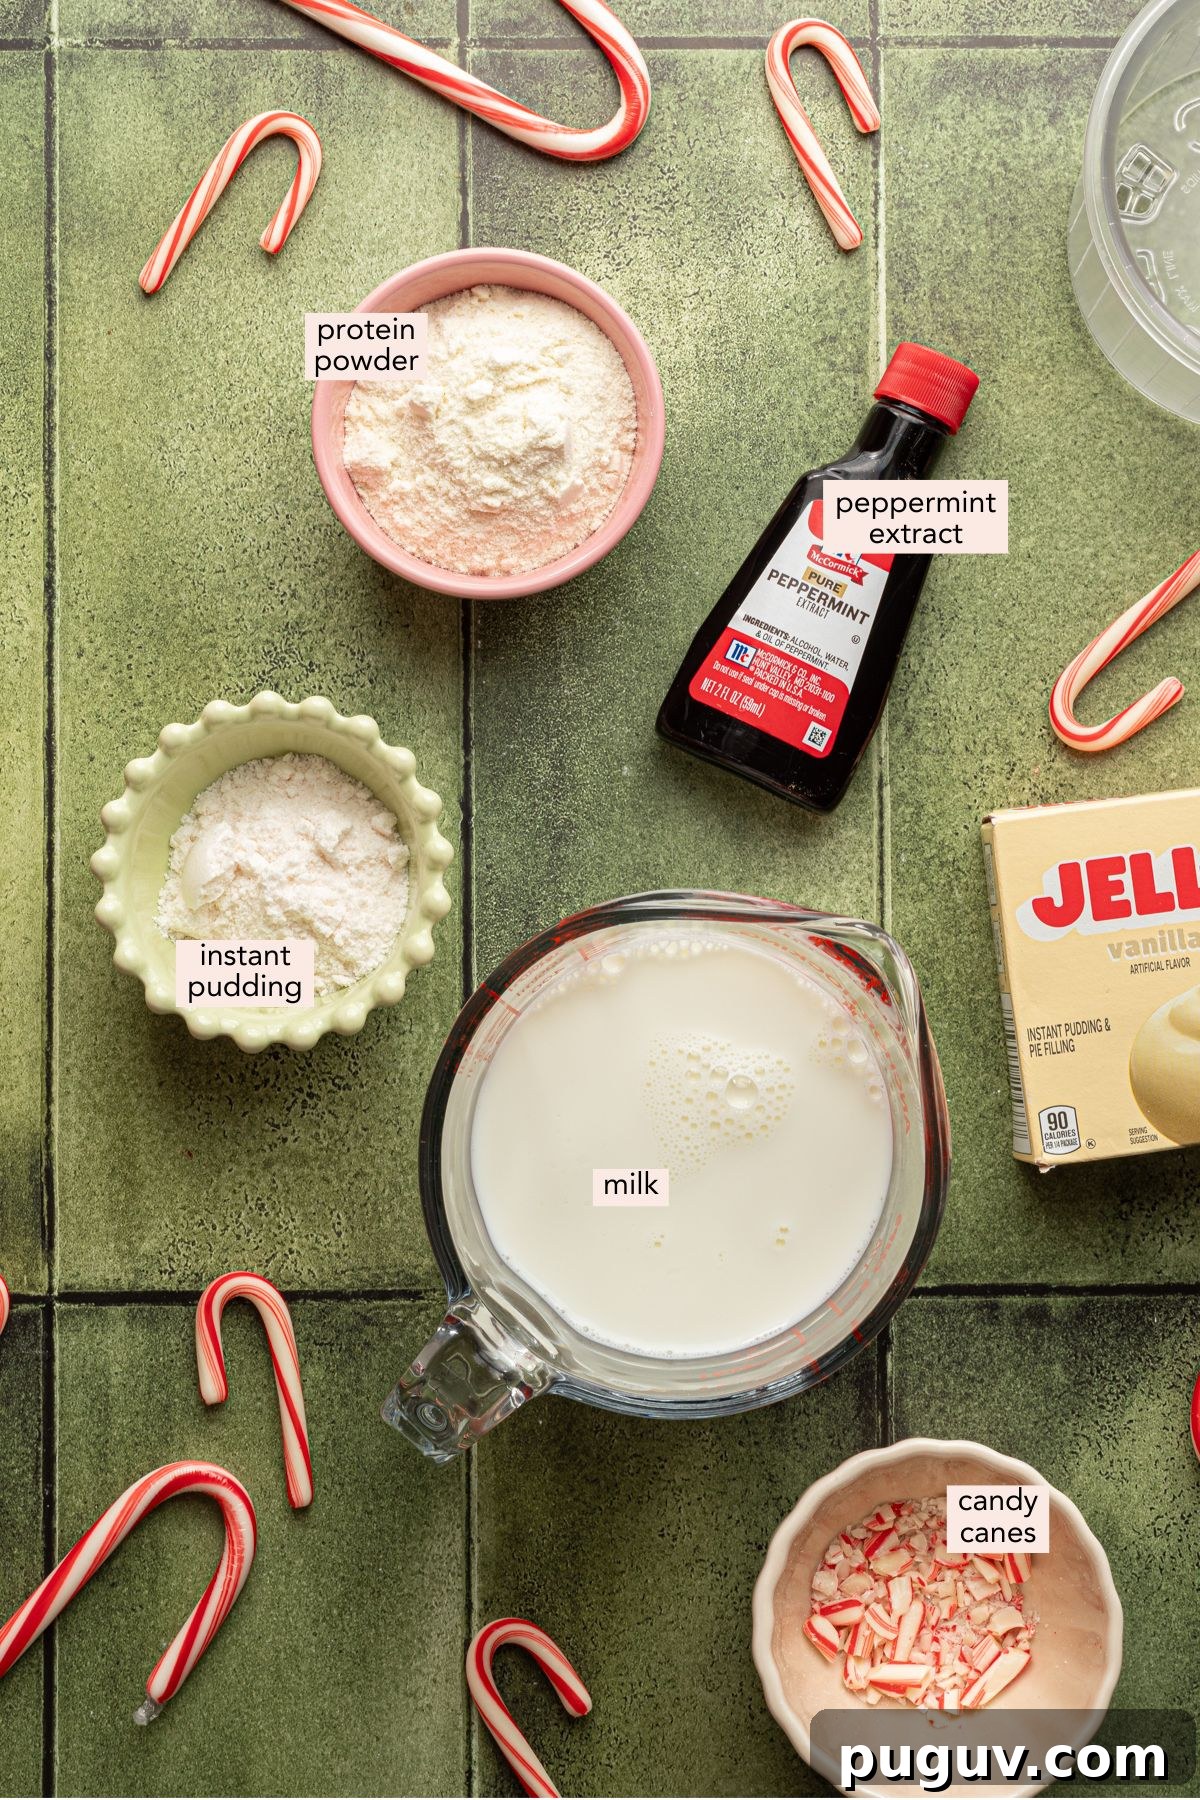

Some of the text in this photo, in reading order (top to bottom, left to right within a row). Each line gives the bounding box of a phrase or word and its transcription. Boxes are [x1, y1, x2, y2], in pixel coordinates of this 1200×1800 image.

[810, 550, 860, 578] McCormick
[808, 571, 842, 594] PURE
[767, 569, 870, 625] PEPPERMINT
[796, 596, 830, 620] EXTRACT
[742, 613, 849, 671] INGREDIENTS: ALCOHOL, WATER,
[755, 630, 829, 671] & OIL OF PEPPERMINT.
[756, 648, 793, 672] McCORMICK
[791, 665, 798, 674] &
[713, 660, 721, 671] Do
[728, 669, 739, 679] use
[753, 680, 770, 693] under
[778, 691, 785, 700] is
[783, 694, 804, 712] missing
[802, 704, 810, 712] or
[752, 656, 771, 671] HUNT
[794, 676, 805, 688] MD
[804, 681, 836, 703] 21031-1100
[754, 667, 779, 686] PACKED
[778, 680, 787, 690] IN
[700, 677, 766, 719] NET 2 FL OZ (59mL)
[1032, 846, 1200, 928] JELL
[1107, 928, 1200, 960] vanilla
[1130, 957, 1191, 975] ARTIFICIAL FLAVOR
[1027, 1017, 1111, 1042] INSTANT PUDDING &
[1029, 1039, 1076, 1058] PIE FILLING
[1047, 1111, 1068, 1131] 90
[1128, 1126, 1148, 1137] SERVING
[1044, 1129, 1077, 1140] CALORIES
[1129, 1134, 1159, 1145] SUGGESTION
